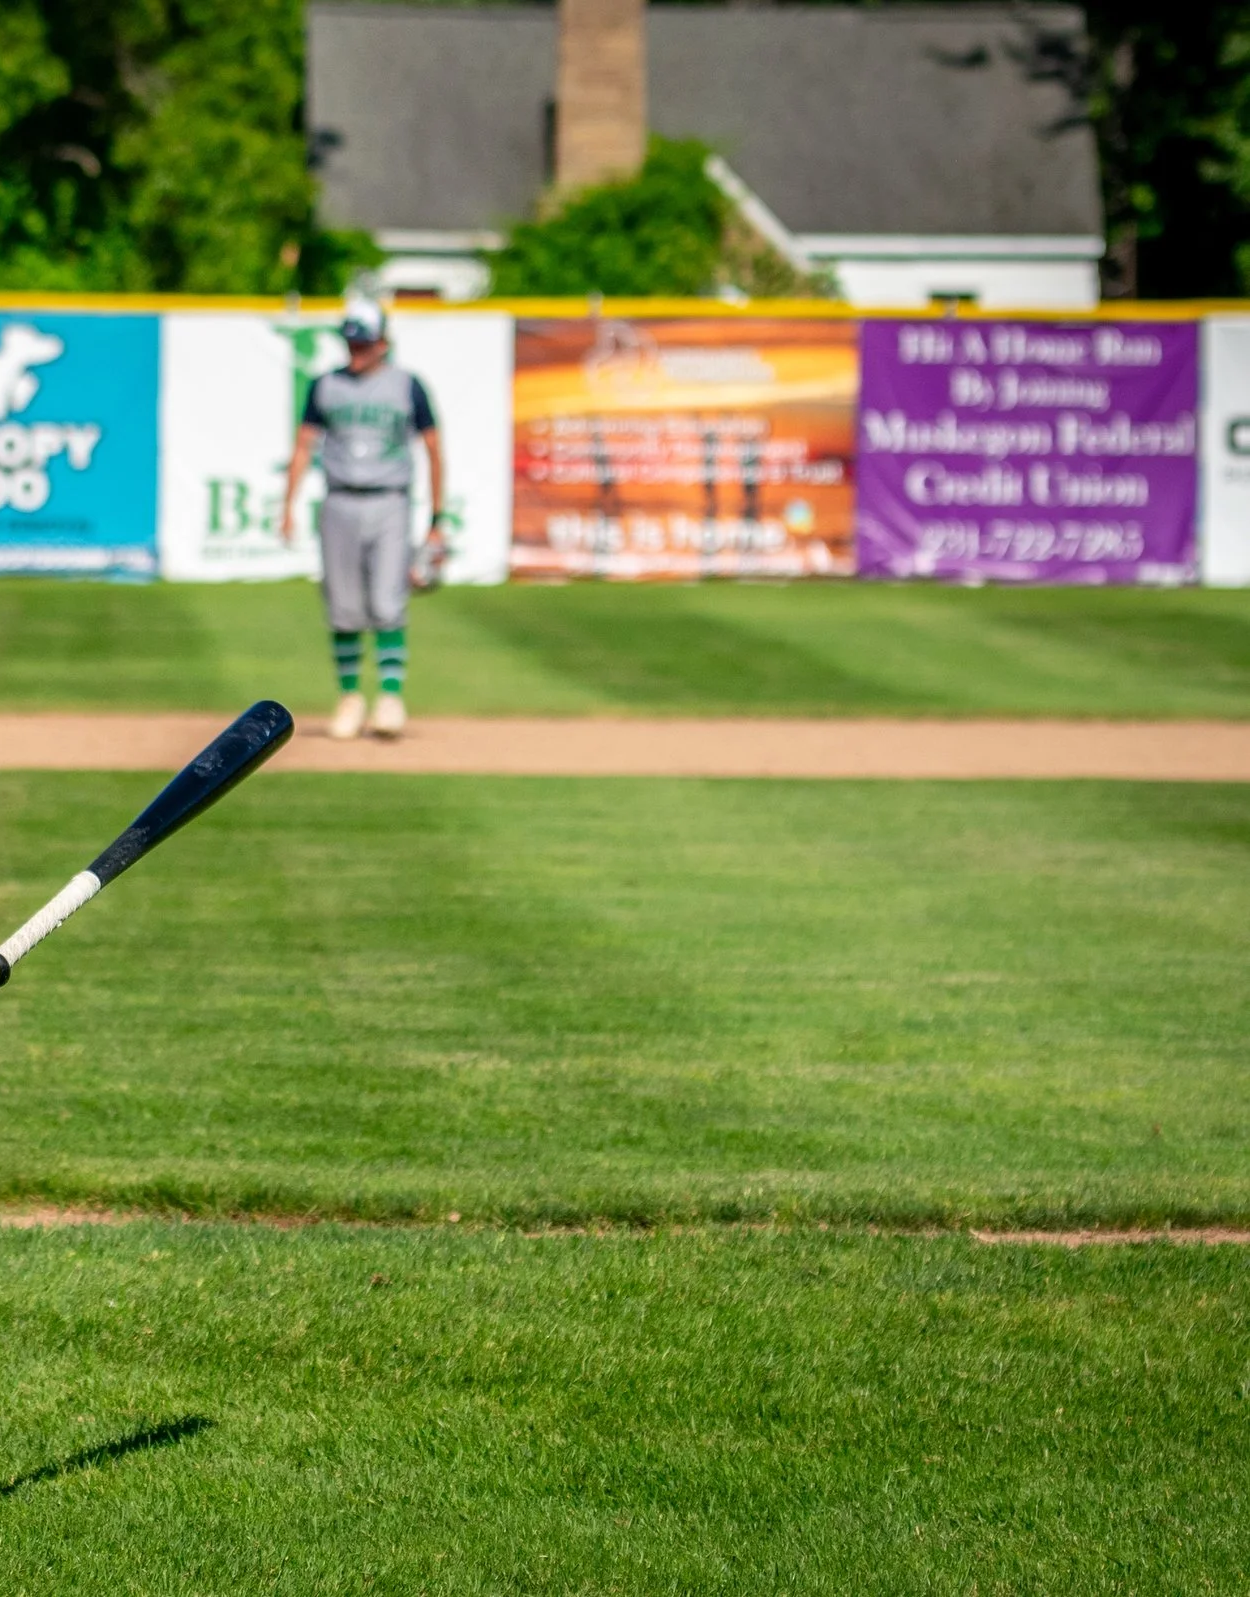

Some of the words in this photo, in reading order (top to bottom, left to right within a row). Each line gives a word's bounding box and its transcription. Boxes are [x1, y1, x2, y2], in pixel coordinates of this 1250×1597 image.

[899, 326, 953, 364] Hit
[961, 327, 987, 364] A
[989, 326, 1088, 365] Home
[1093, 328, 1162, 366] Run
[952, 367, 994, 411] By
[997, 368, 1110, 413] Joining
[863, 409, 1053, 460] Muskegon
[1057, 411, 1196, 456] Federal
[904, 460, 1024, 506] Credit
[1028, 463, 1149, 507] Union
[548, 510, 624, 552] this
